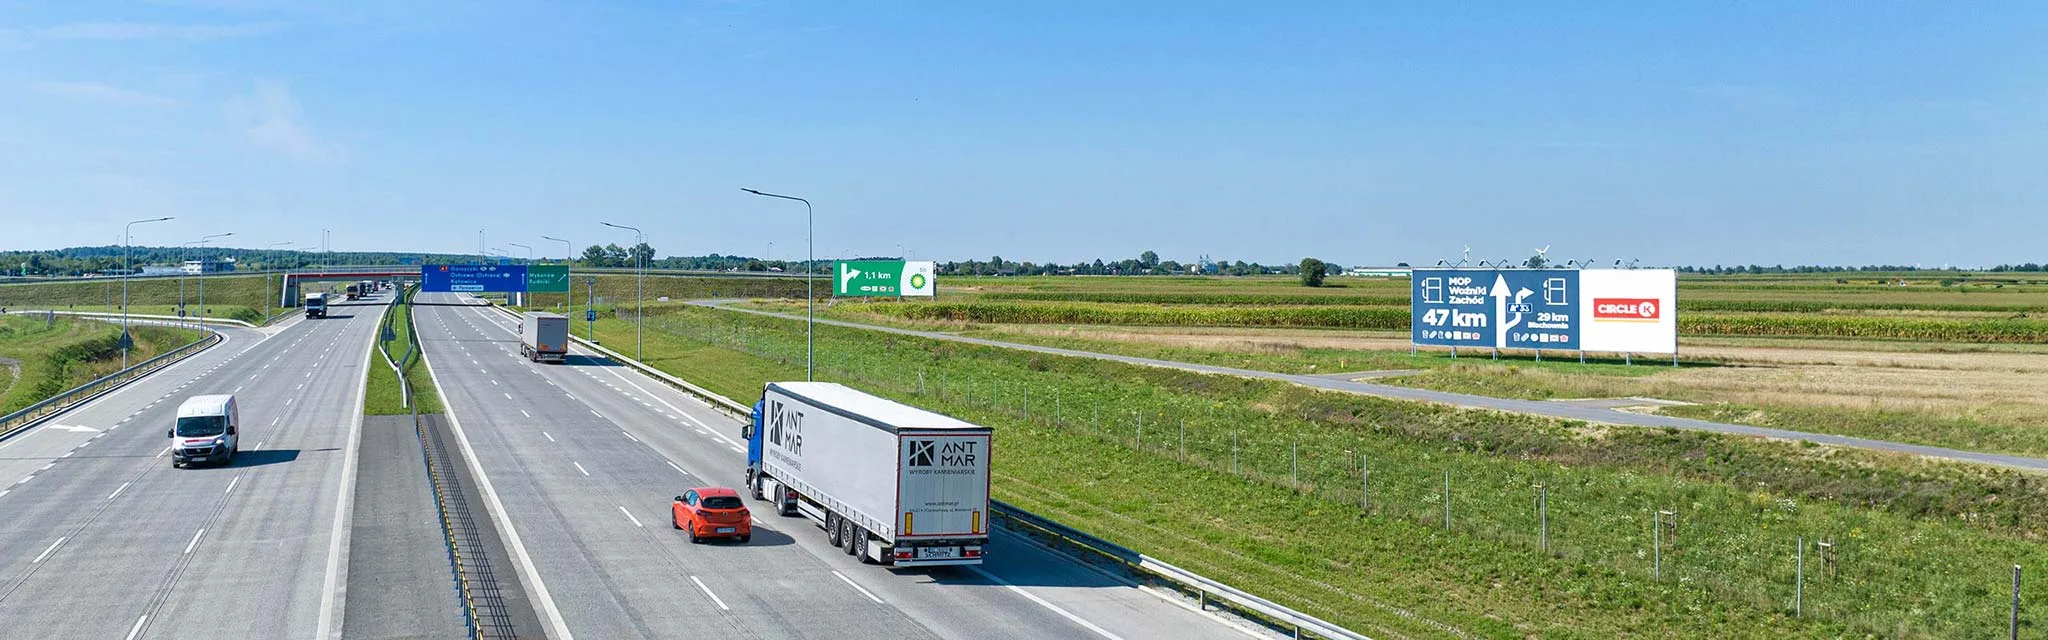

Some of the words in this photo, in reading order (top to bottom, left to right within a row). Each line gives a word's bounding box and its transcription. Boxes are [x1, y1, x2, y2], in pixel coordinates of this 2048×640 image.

[864, 272, 876, 280] 1,1
[1449, 277, 1472, 286] MOP
[1449, 295, 1485, 305] Zachód
[1597, 304, 1638, 314] CIRCLE
[1422, 308, 1449, 327] 47
[1452, 308, 1487, 328] km
[1537, 312, 1550, 322] 29
[1550, 312, 1569, 322] km
[786, 409, 804, 433] ANT
[785, 431, 802, 456] MAR
[941, 441, 977, 454] ANT
[941, 454, 976, 467] MAR
